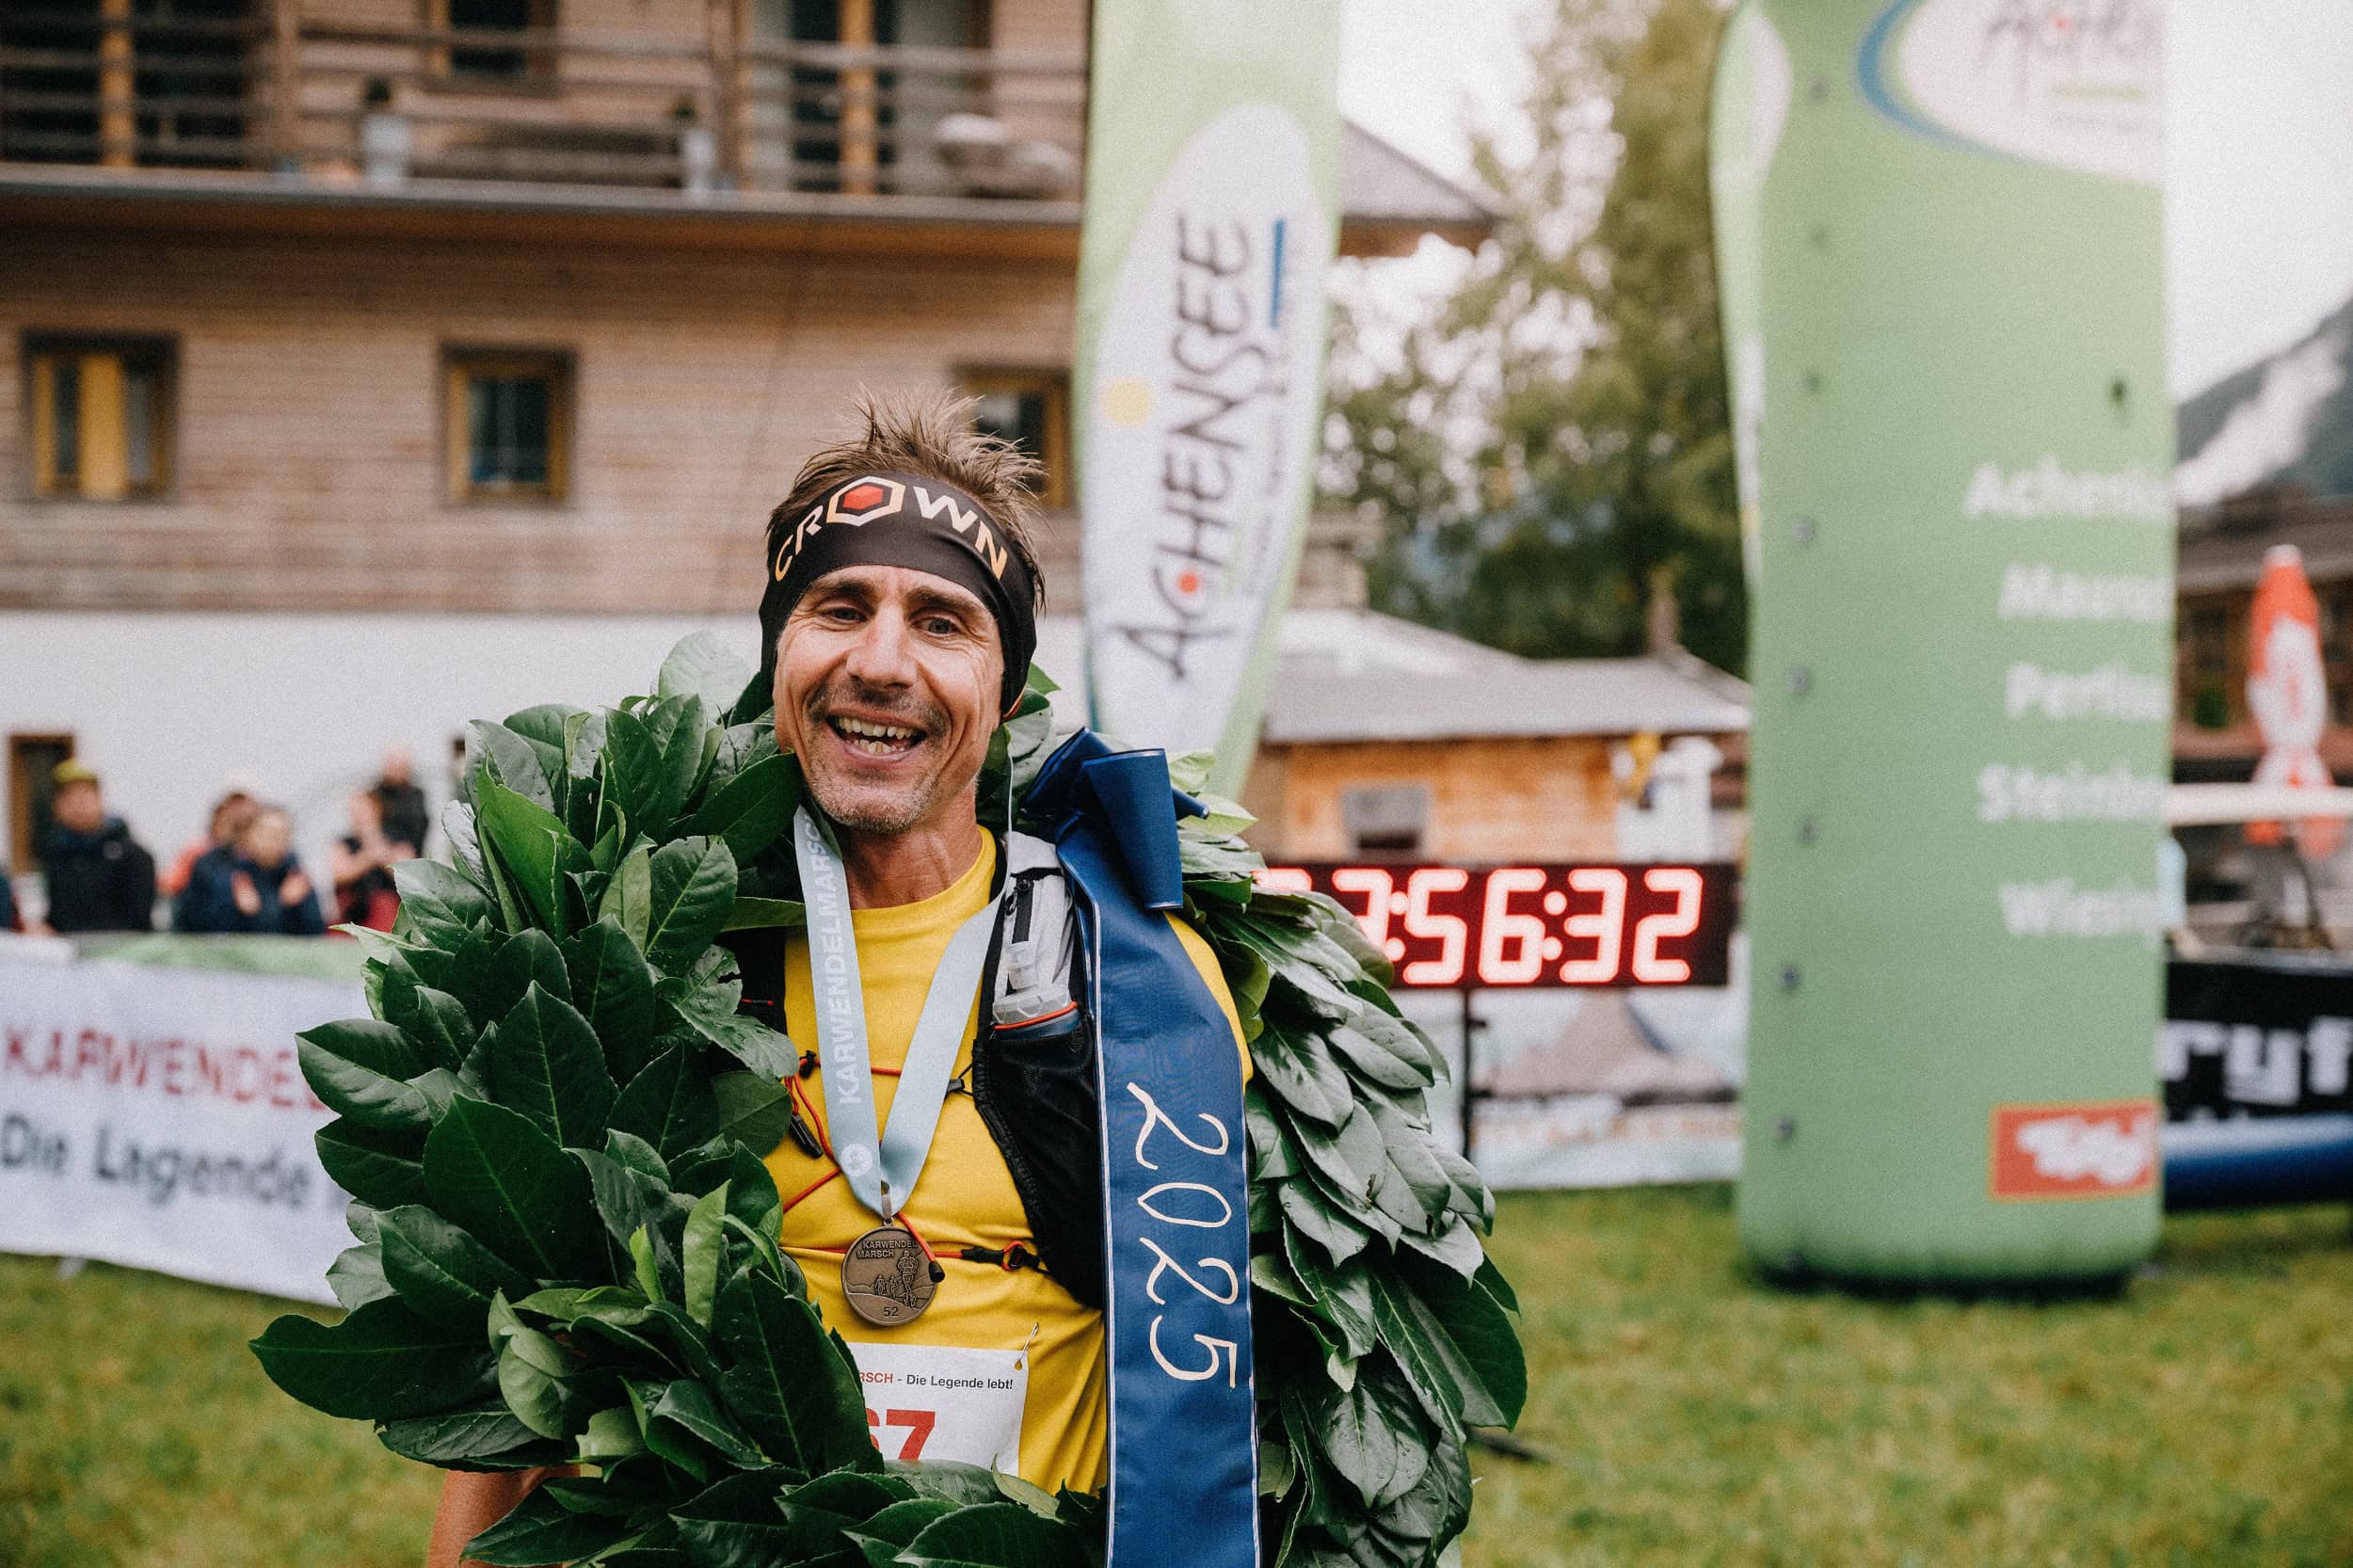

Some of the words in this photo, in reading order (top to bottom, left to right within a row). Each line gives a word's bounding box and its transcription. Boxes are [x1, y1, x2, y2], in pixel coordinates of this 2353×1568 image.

[1111, 215, 1288, 681] ACHENSEE
[775, 475, 1008, 582] CROWN
[804, 813, 863, 1105] KARWENDELMARSC
[1250, 867, 1704, 984] 3:56:32
[0, 1112, 69, 1176] Die
[97, 1122, 310, 1212] Legende
[856, 1250, 894, 1259] MARSCH
[862, 1240, 919, 1250] KARWENDEL
[1127, 1081, 1239, 1389] 2025
[884, 1306, 899, 1318] 52
[906, 1374, 927, 1385] Die
[931, 1376, 984, 1389] Legende
[987, 1378, 1014, 1390] lebt!
